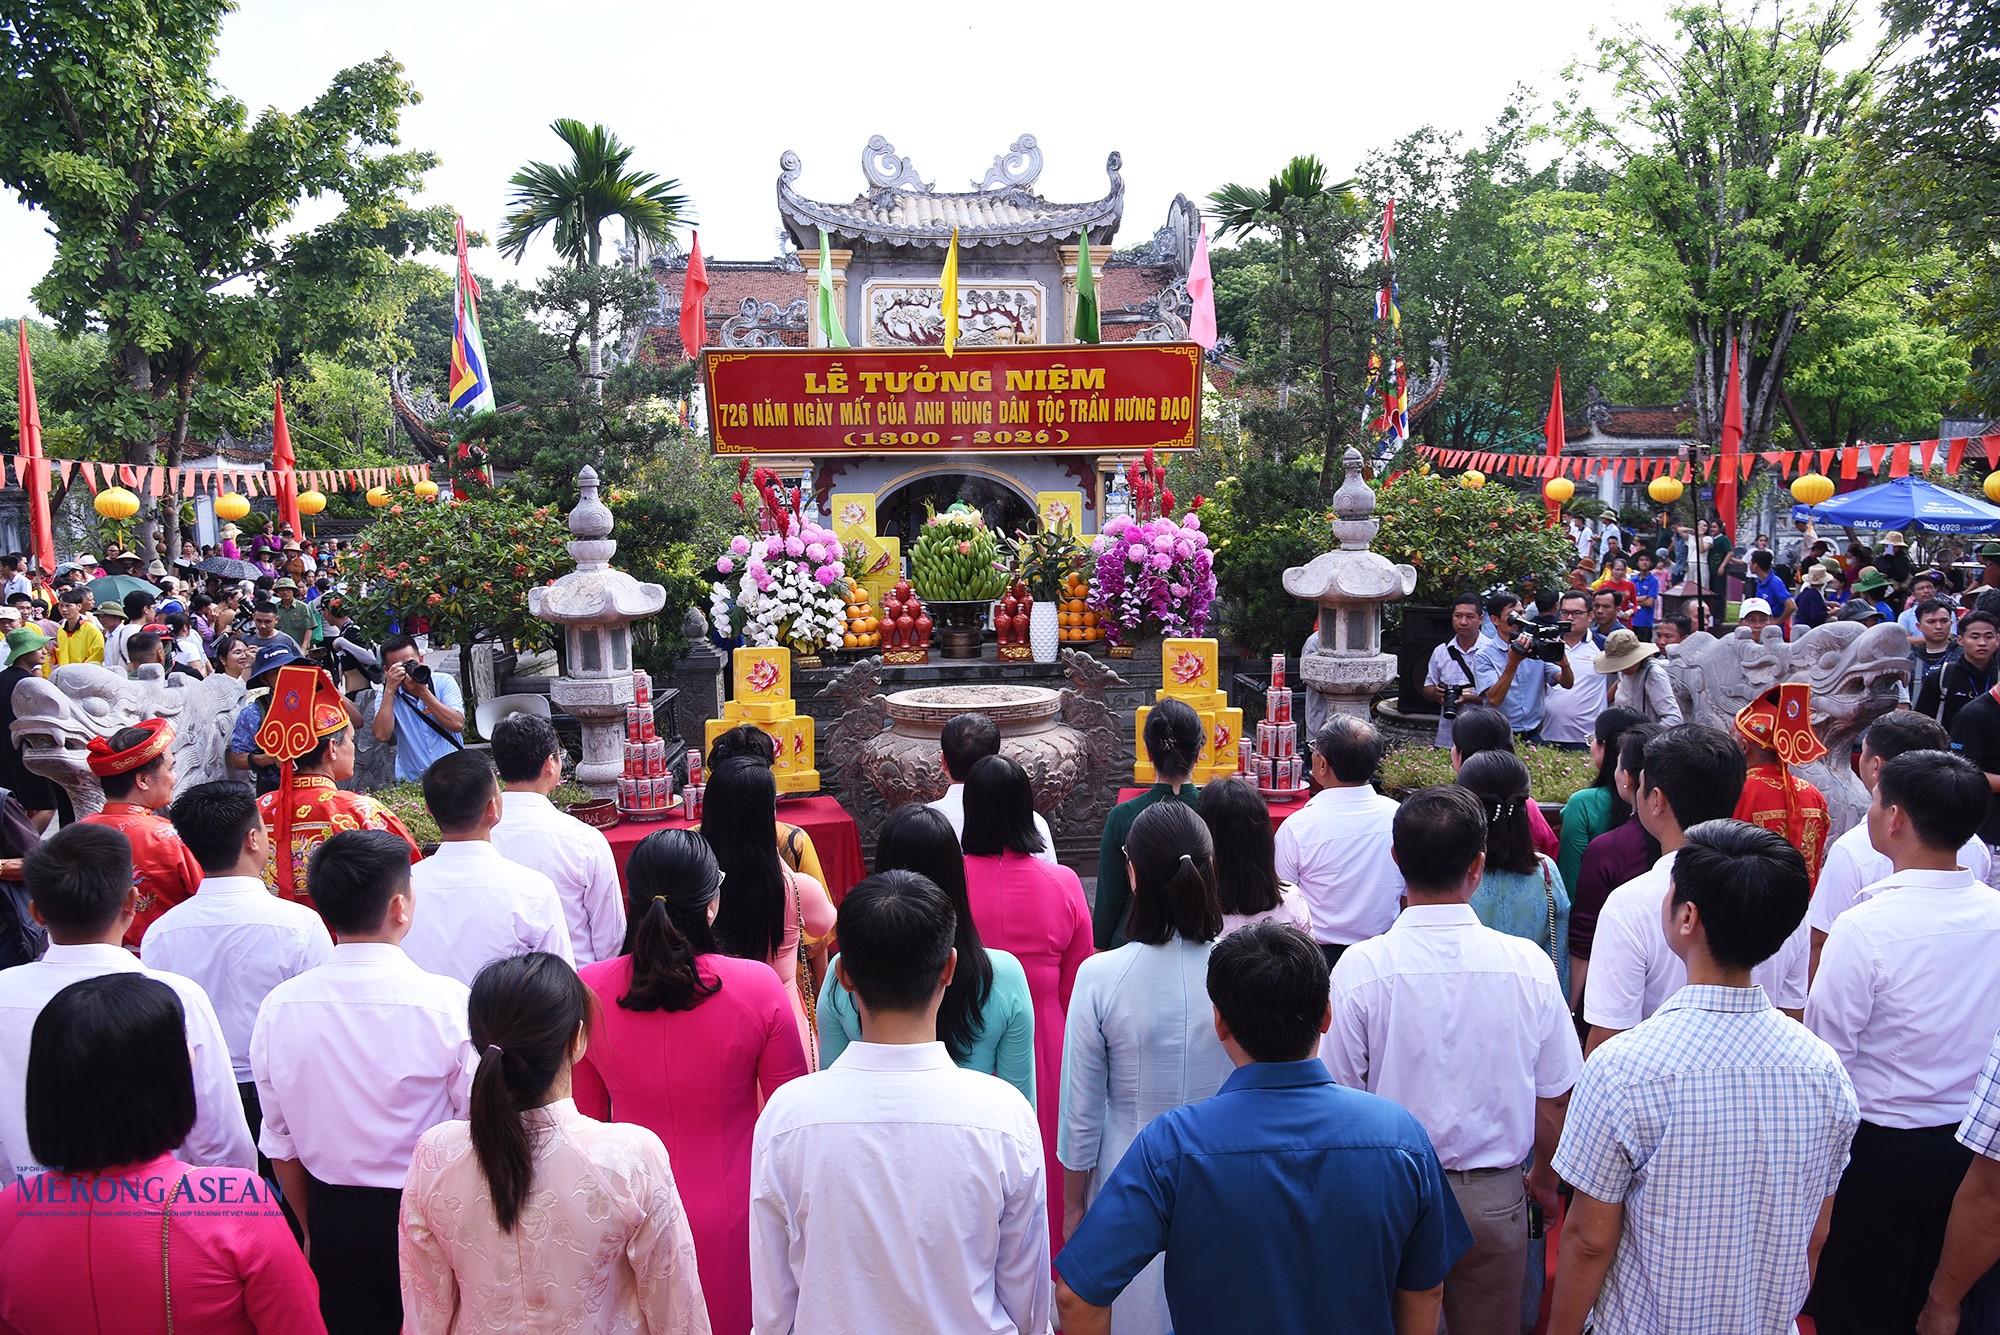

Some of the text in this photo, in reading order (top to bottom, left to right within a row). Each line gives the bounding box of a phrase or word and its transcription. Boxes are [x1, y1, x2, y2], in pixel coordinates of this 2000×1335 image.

[804, 362, 1106, 394] LỄ TƯỞNG NIỆM
[719, 392, 1190, 427] 726 NĂM NGÀY MẤT CỦA ANH HÙNG DÂN TỘC TRẦN HƯNG ĐẠO
[843, 431, 941, 446] (1300
[1853, 519, 1883, 528] GIÁ TỐT
[1940, 523, 1961, 532] 6928
